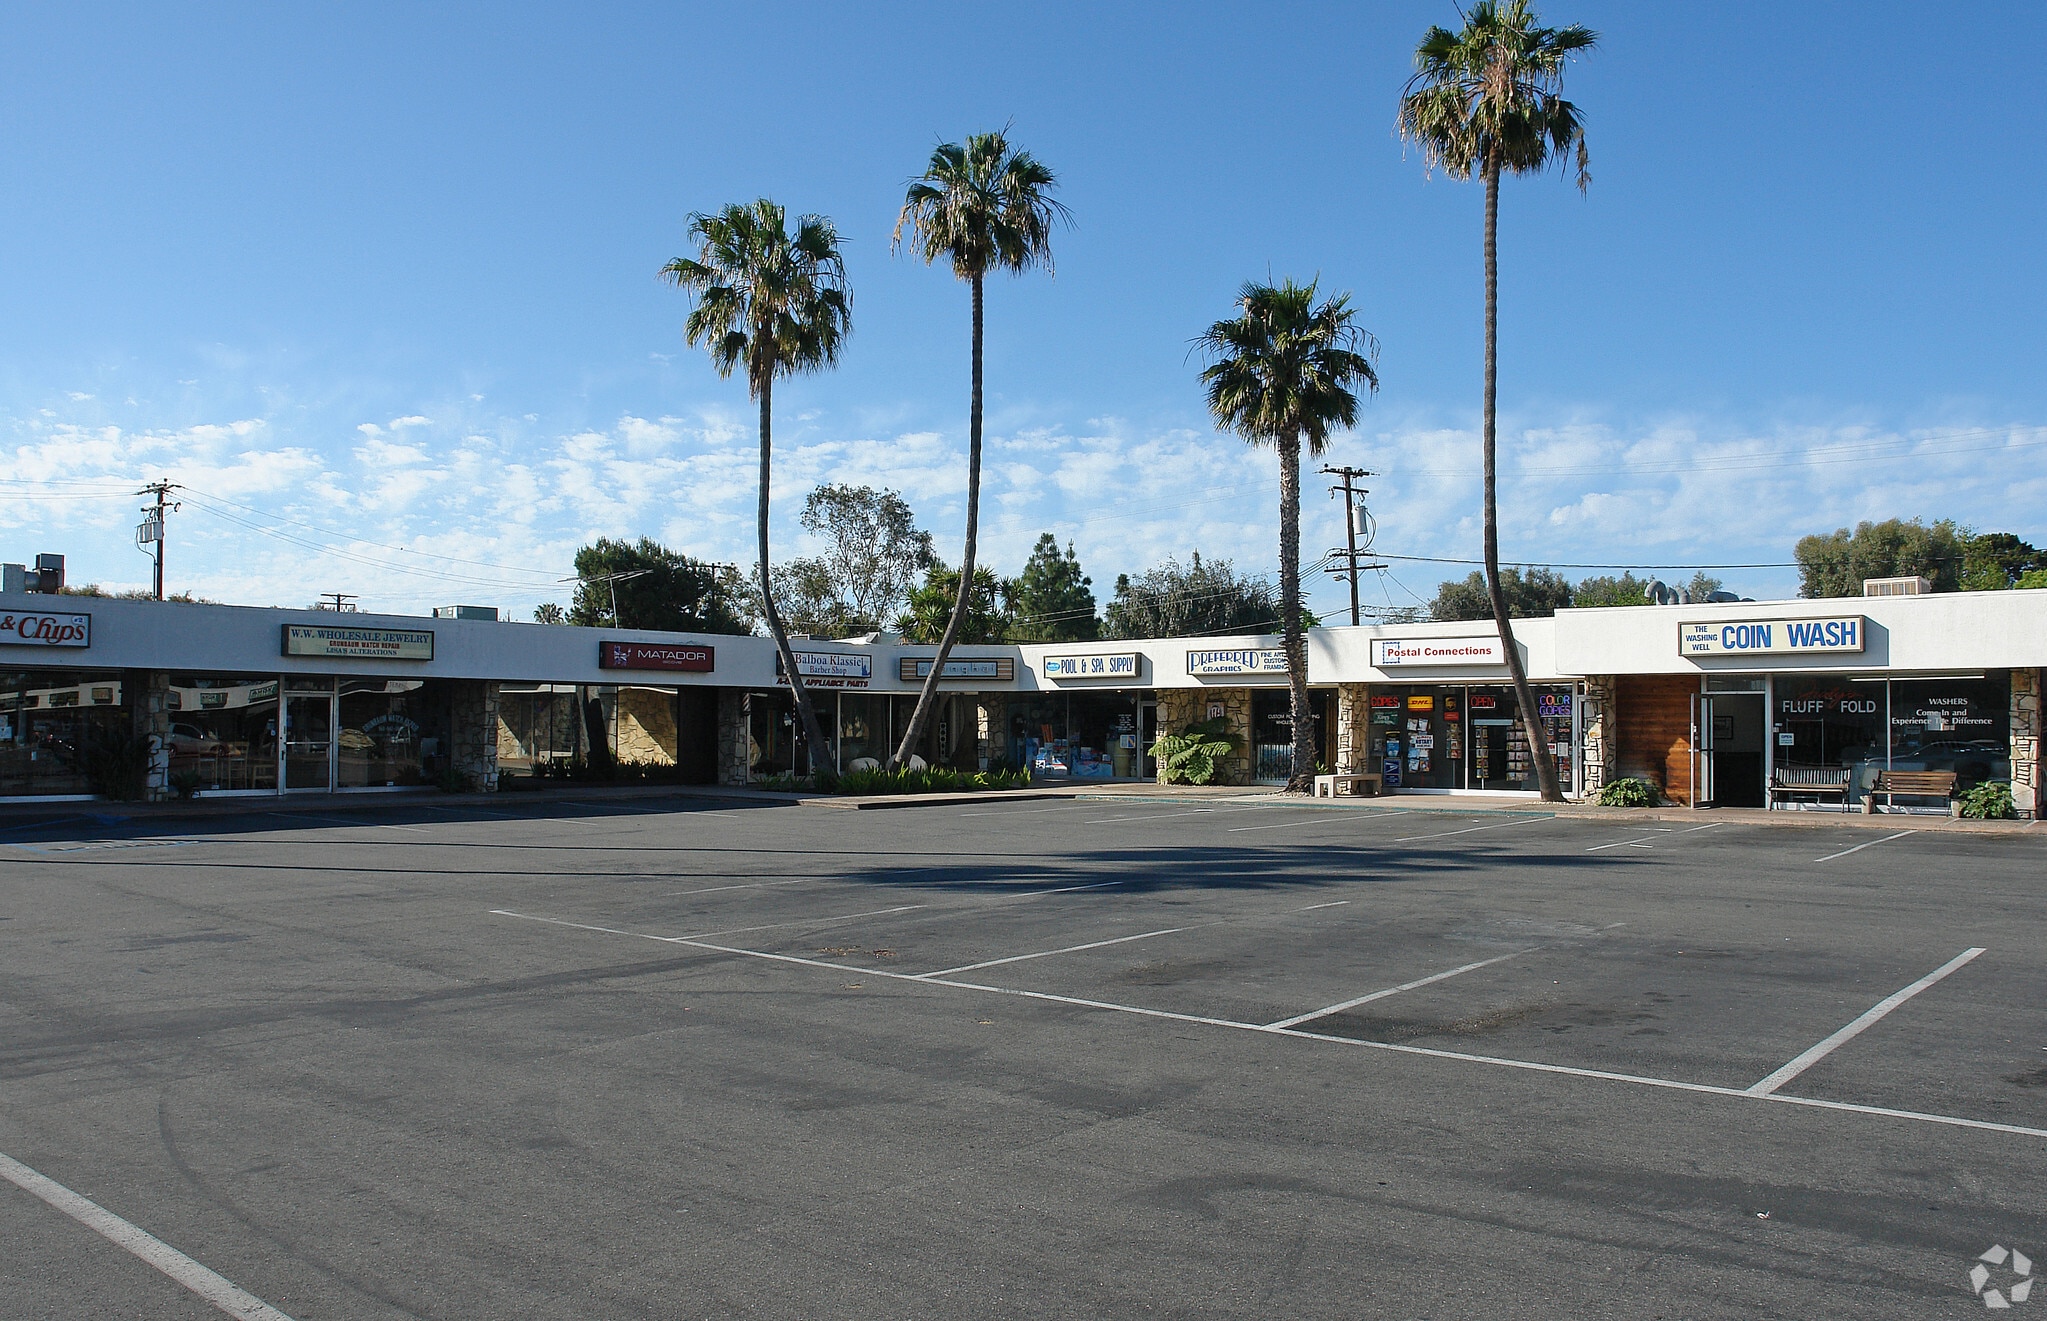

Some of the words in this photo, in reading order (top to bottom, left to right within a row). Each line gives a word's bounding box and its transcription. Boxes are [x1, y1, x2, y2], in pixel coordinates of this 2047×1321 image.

[0, 615, 16, 631] &
[18, 616, 86, 644] Chips
[1694, 625, 1708, 633] THE
[291, 628, 315, 639] W.W.
[317, 630, 382, 642] WHOLESALE
[382, 632, 430, 644] JEWELRY
[1685, 634, 1718, 642] WASHING
[1721, 624, 1772, 650] COIN
[1786, 621, 1857, 648] WASH
[361, 641, 380, 649] WATCH
[381, 642, 401, 650] REPAIR
[1691, 643, 1711, 651] WELL
[349, 648, 398, 656] ALTERATIONS
[637, 649, 706, 661] MATADOR
[1387, 647, 1421, 657] Postal
[1424, 646, 1492, 656] Connections
[795, 653, 827, 664] Balboa
[1190, 651, 1260, 672] PREFERRED
[809, 665, 831, 674] Barber
[831, 665, 847, 676] Shop
[1061, 659, 1077, 674] POOL
[1081, 658, 1087, 673] &
[1091, 658, 1105, 673] SPA
[1109, 656, 1134, 673] SUPPLY
[804, 679, 844, 687] APPLIANCE
[846, 680, 869, 688] PARTS
[1370, 695, 1399, 707] COPIES
[1470, 696, 1495, 706] OPEN
[1539, 694, 1571, 706] COLOR
[1928, 697, 1969, 706] WASHERS
[1539, 705, 1571, 715] COPIES
[1782, 700, 1824, 713] FLUFF
[1840, 700, 1877, 713] FOLD
[1916, 708, 1940, 716] Come
[1941, 708, 1950, 716] In
[1952, 708, 1967, 716] and
[1891, 717, 1932, 726] Experience
[1951, 717, 1993, 725] Difference
